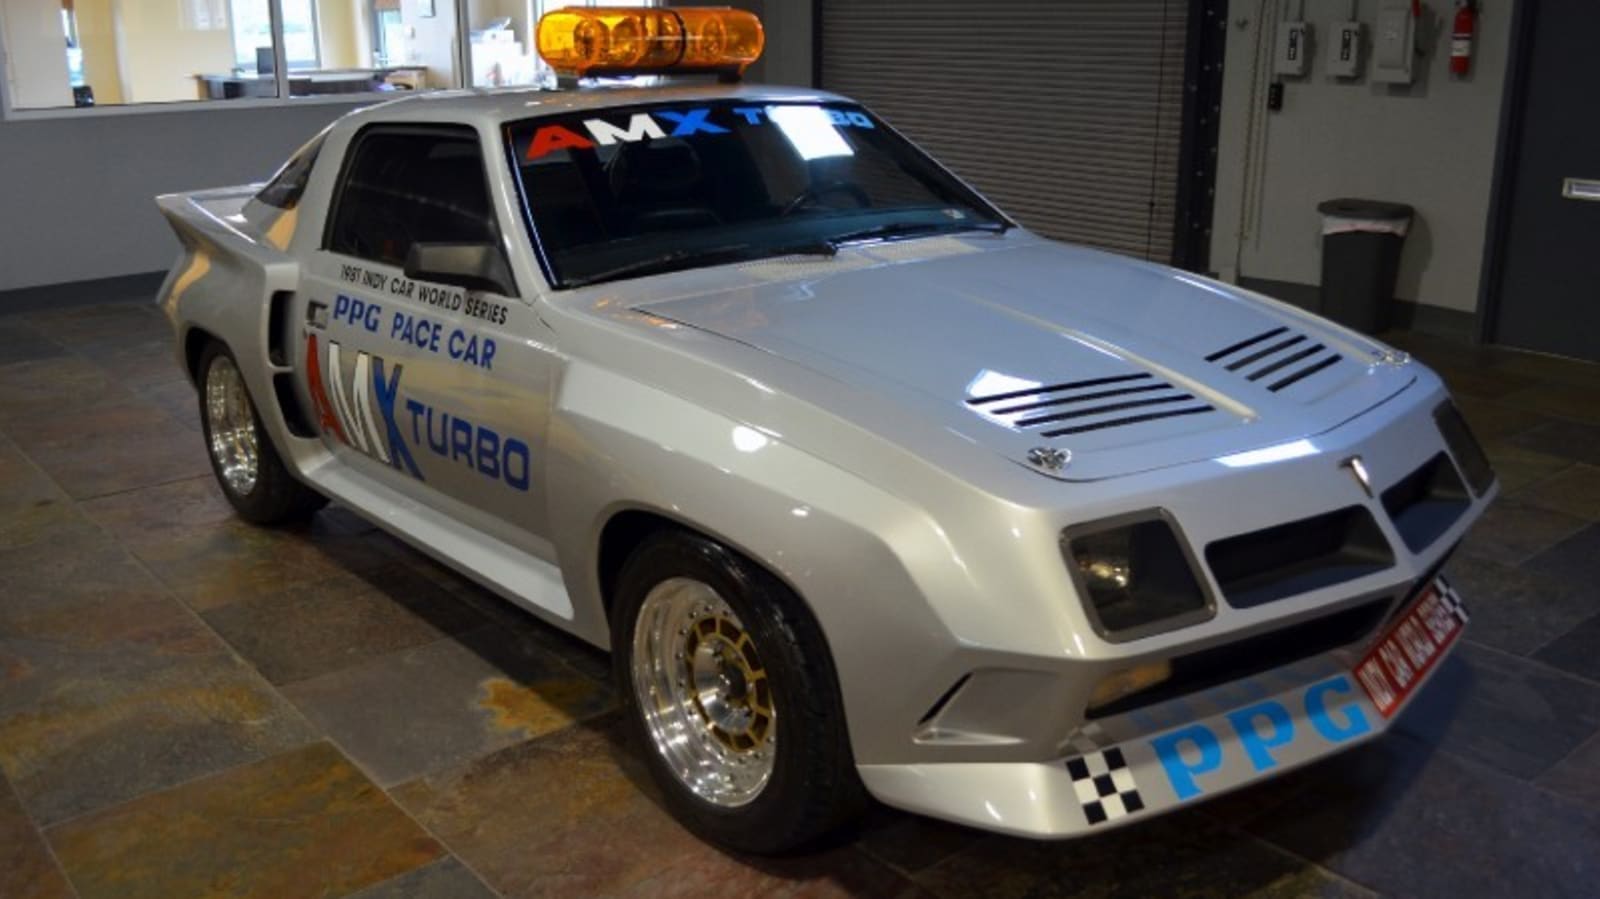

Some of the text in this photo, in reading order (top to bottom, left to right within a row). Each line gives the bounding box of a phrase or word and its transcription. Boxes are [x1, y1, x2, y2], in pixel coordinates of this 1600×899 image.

[526, 105, 875, 159] AMX TBO
[333, 294, 497, 370] PPG PACE CAR
[340, 264, 509, 326] 1981 INDY CAR WORLD SERIES
[305, 333, 530, 492] AMX TURBO
[1148, 674, 1373, 802] PPG
